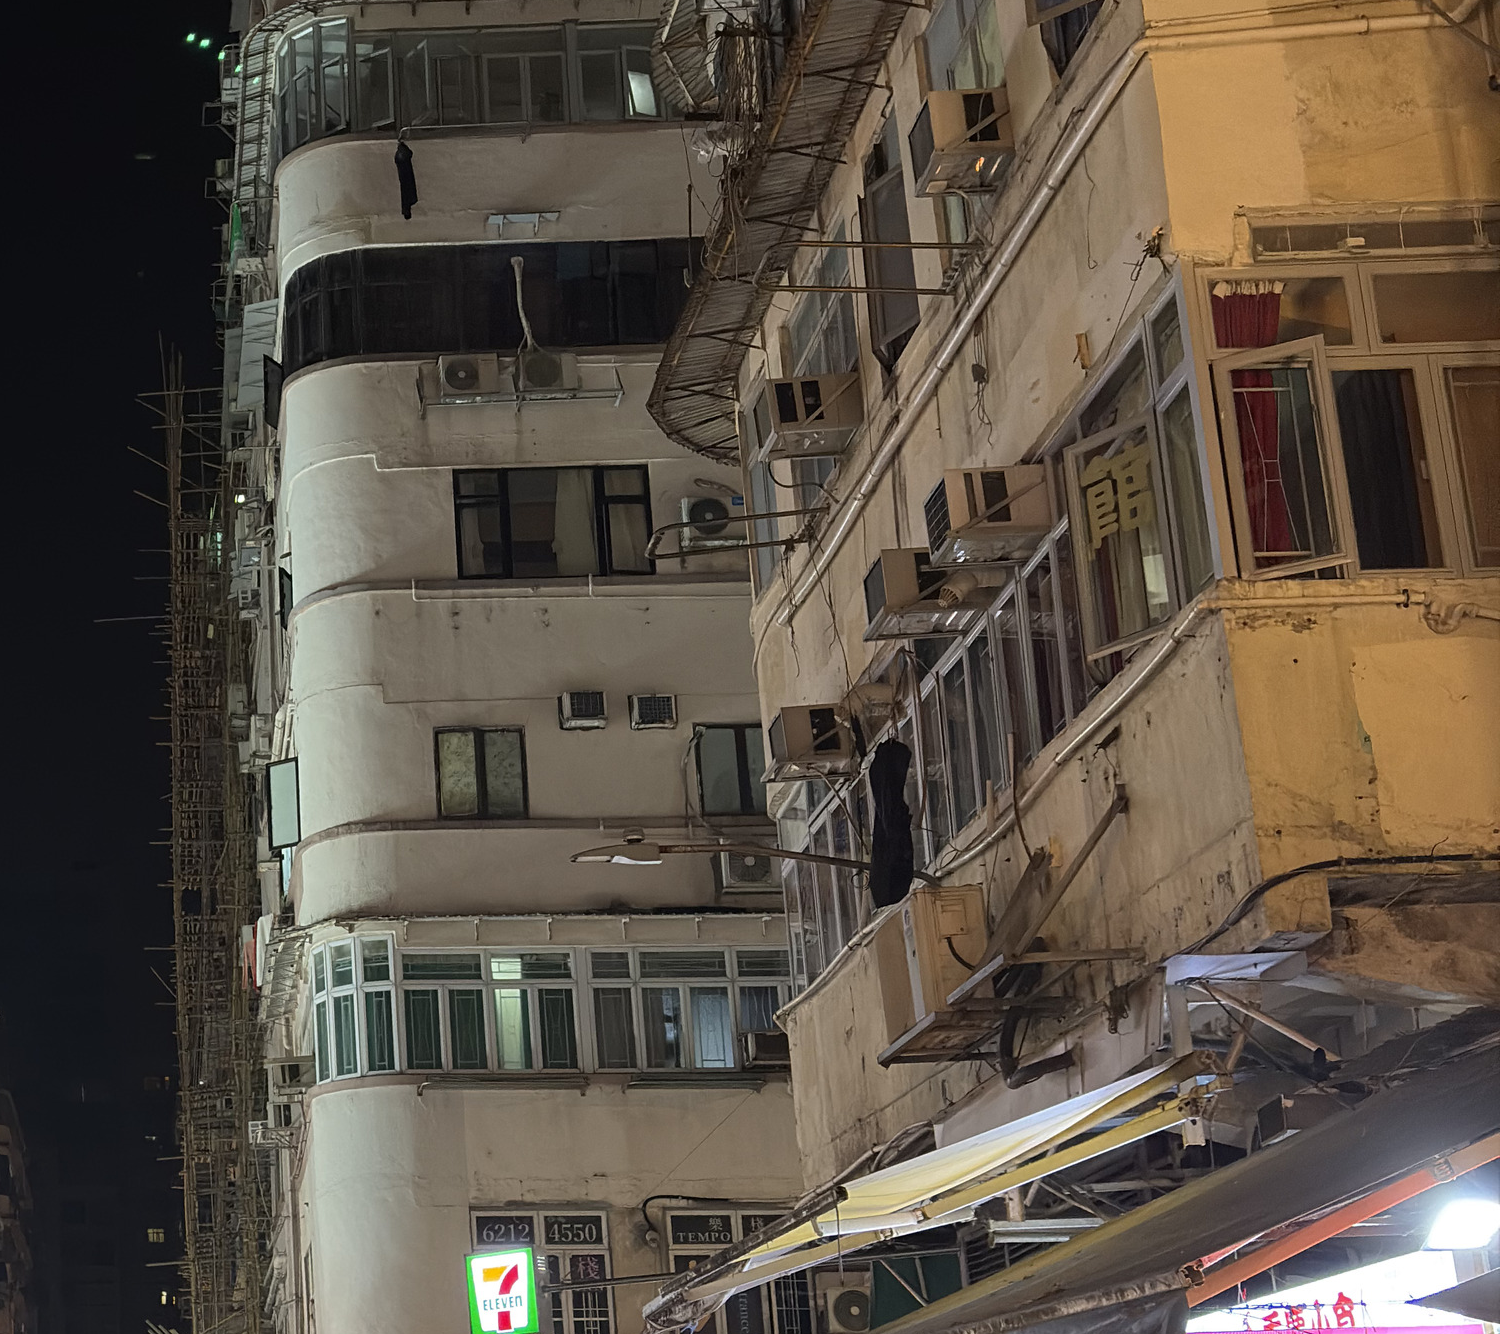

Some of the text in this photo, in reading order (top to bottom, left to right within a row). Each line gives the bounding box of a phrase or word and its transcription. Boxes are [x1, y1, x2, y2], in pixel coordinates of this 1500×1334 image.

[1079, 443, 1160, 562] 館
[483, 1223, 598, 1243] 6212 4550
[676, 1232, 732, 1243] TEMPO
